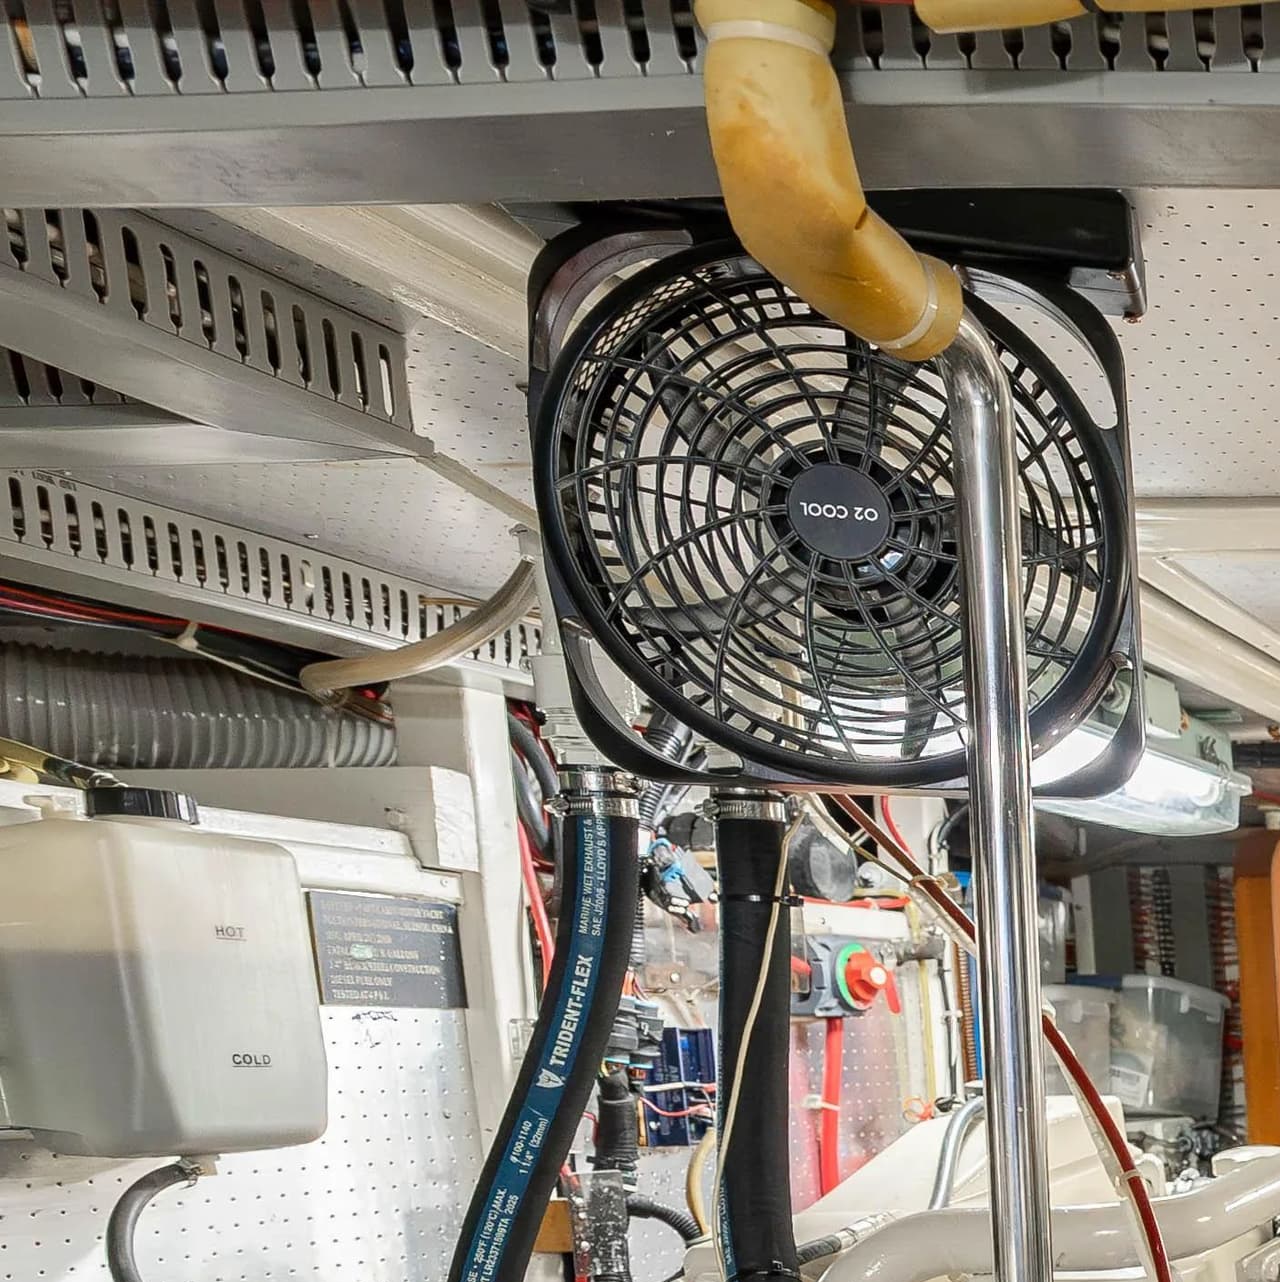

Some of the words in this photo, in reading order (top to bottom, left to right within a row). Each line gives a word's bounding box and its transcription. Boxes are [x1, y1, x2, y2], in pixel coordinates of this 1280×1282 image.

[800, 502, 848, 519] COOL
[853, 506, 878, 521] O2
[584, 828, 593, 873] EXHAUST
[583, 877, 593, 895] WET
[578, 896, 592, 935] MARINE
[215, 925, 245, 938] HOT
[592, 918, 602, 937] SAE
[549, 954, 594, 1066] TRIDENT-FLEX
[232, 1054, 272, 1065] COLD
